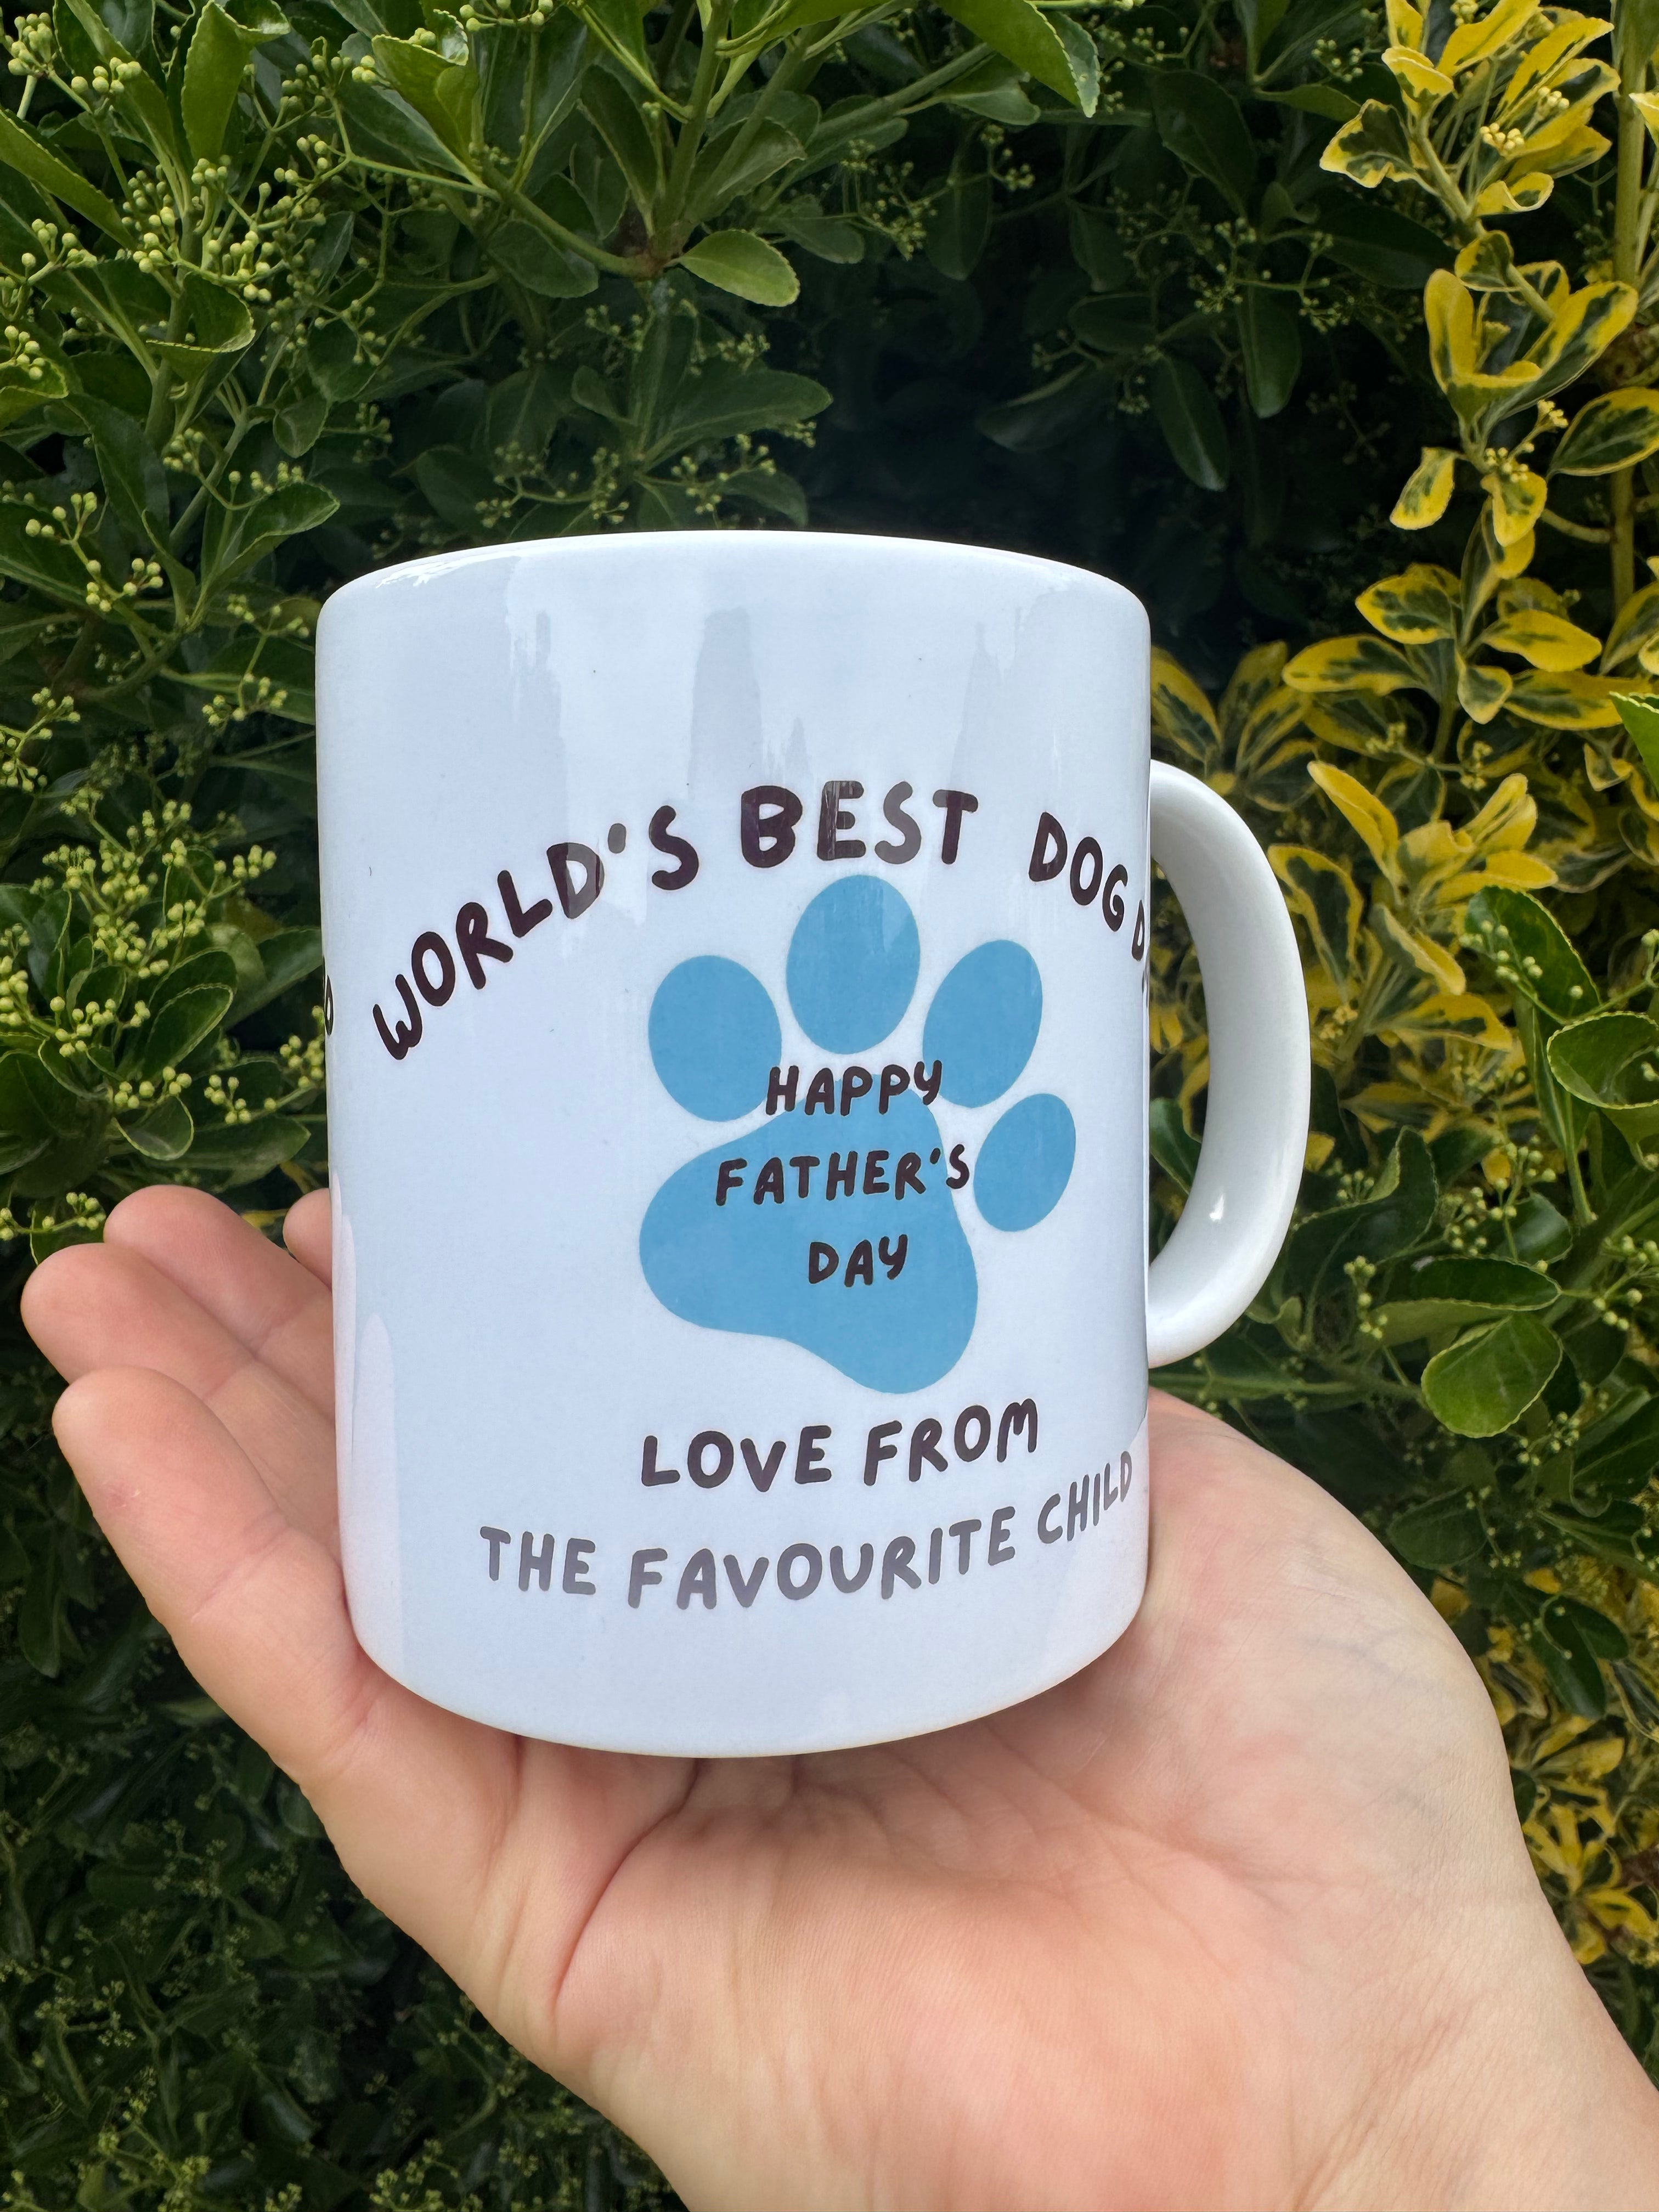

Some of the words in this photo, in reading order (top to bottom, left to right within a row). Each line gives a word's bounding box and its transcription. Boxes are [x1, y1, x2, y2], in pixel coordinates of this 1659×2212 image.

[373, 805, 699, 1061] WORLD'S
[740, 780, 979, 868] BEST
[1028, 811, 1128, 932] DOG
[765, 1059, 943, 1116] HAPPY
[715, 1144, 970, 1207] FATHER'S
[808, 1234, 909, 1288] DAY
[641, 1425, 833, 1493] LOVE
[863, 1398, 1038, 1486] FROM
[479, 1525, 597, 1595] THE
[628, 1505, 1016, 1610] FAVOURITE
[1037, 1451, 1132, 1544] CHILD
